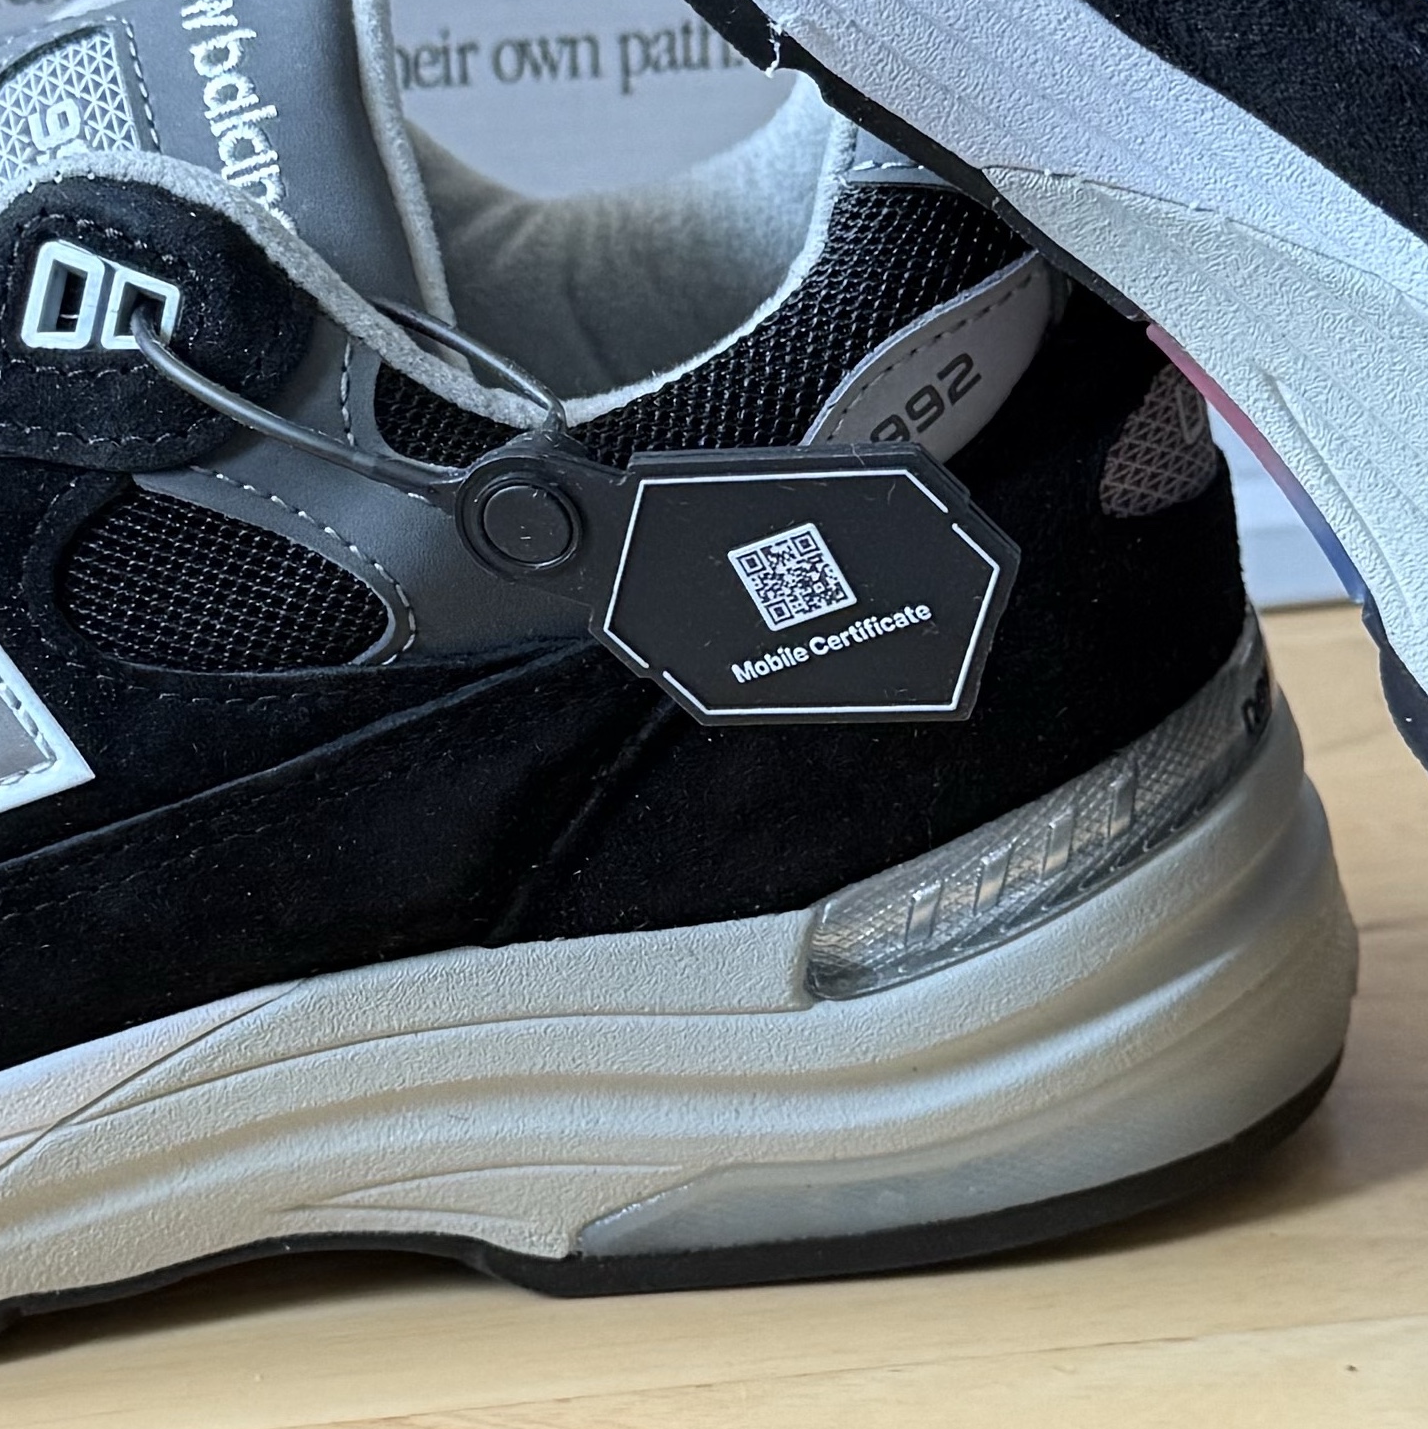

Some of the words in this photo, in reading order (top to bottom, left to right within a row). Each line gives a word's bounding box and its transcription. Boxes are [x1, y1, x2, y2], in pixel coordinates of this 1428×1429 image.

[491, 30, 601, 84] own
[730, 645, 810, 684] Mobile
[808, 604, 933, 657] Certificate
